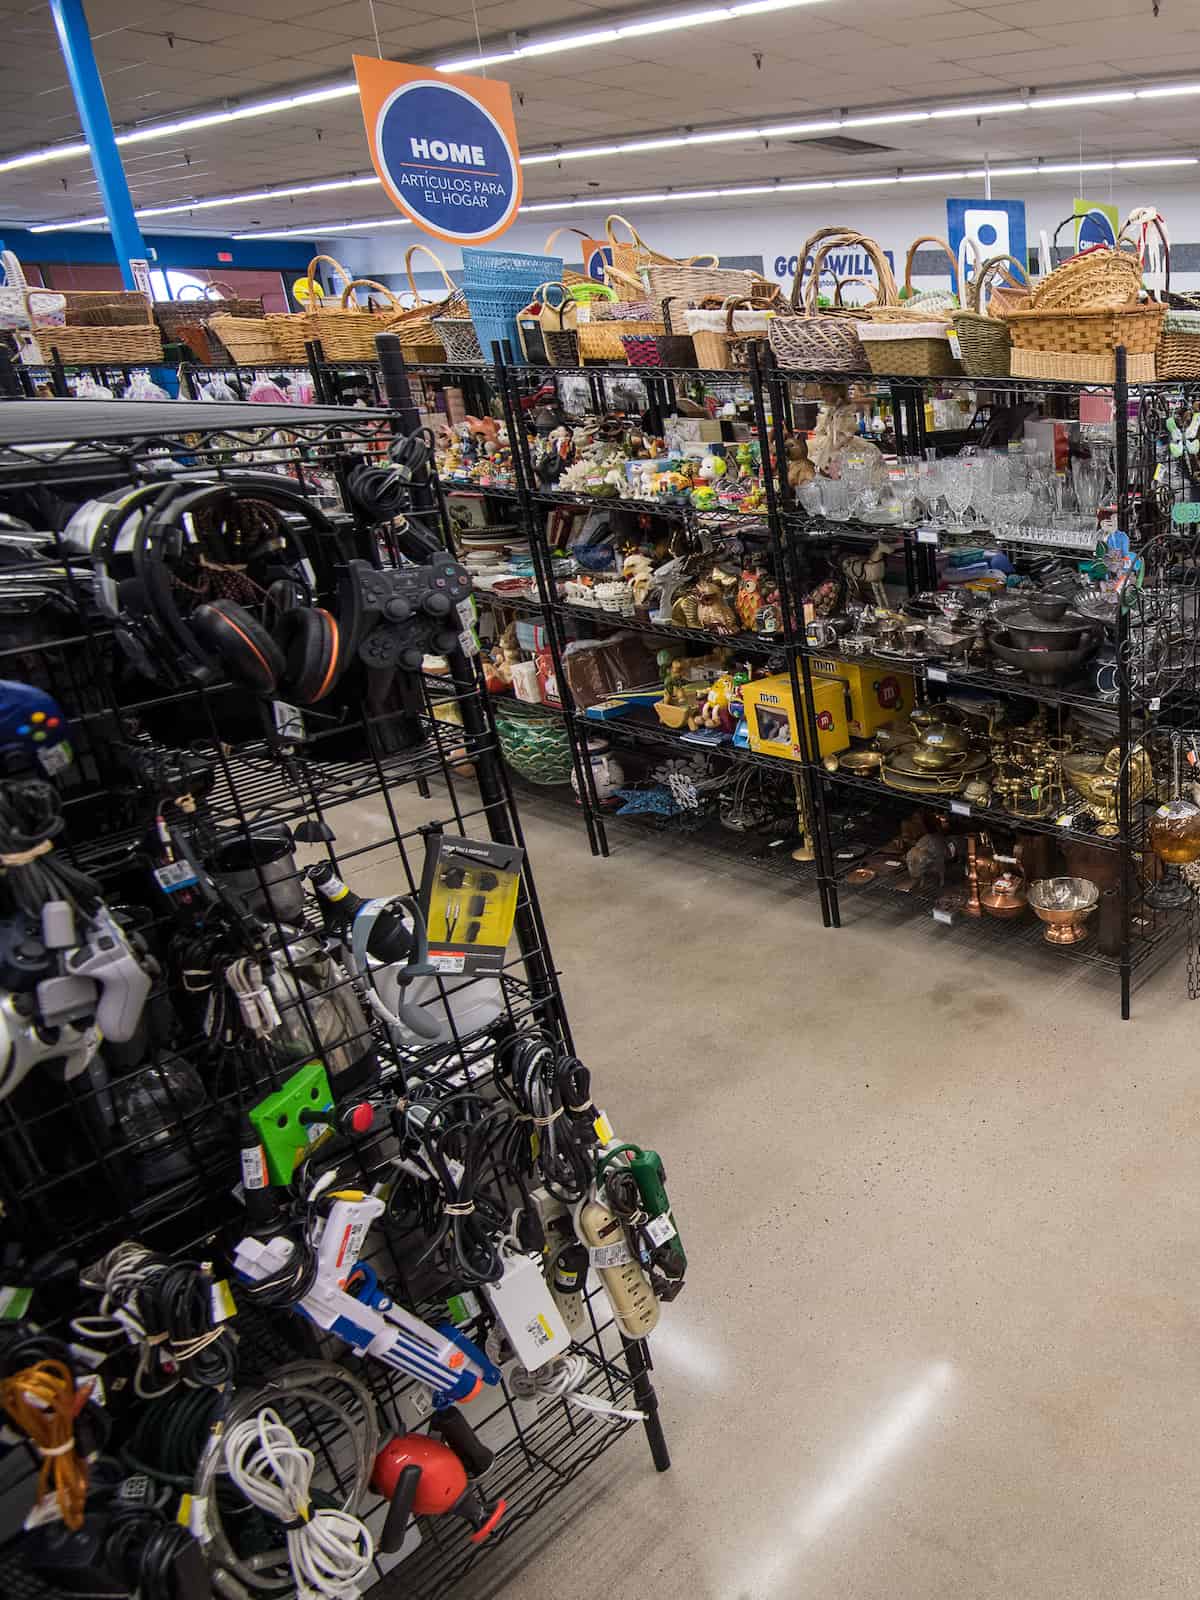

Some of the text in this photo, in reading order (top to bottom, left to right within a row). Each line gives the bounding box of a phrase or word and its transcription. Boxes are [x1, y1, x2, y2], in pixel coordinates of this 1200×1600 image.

[410, 138, 486, 166] HOME
[401, 170, 505, 196] ARTÍCULOS PARA
[425, 190, 488, 208] EL HOGAR
